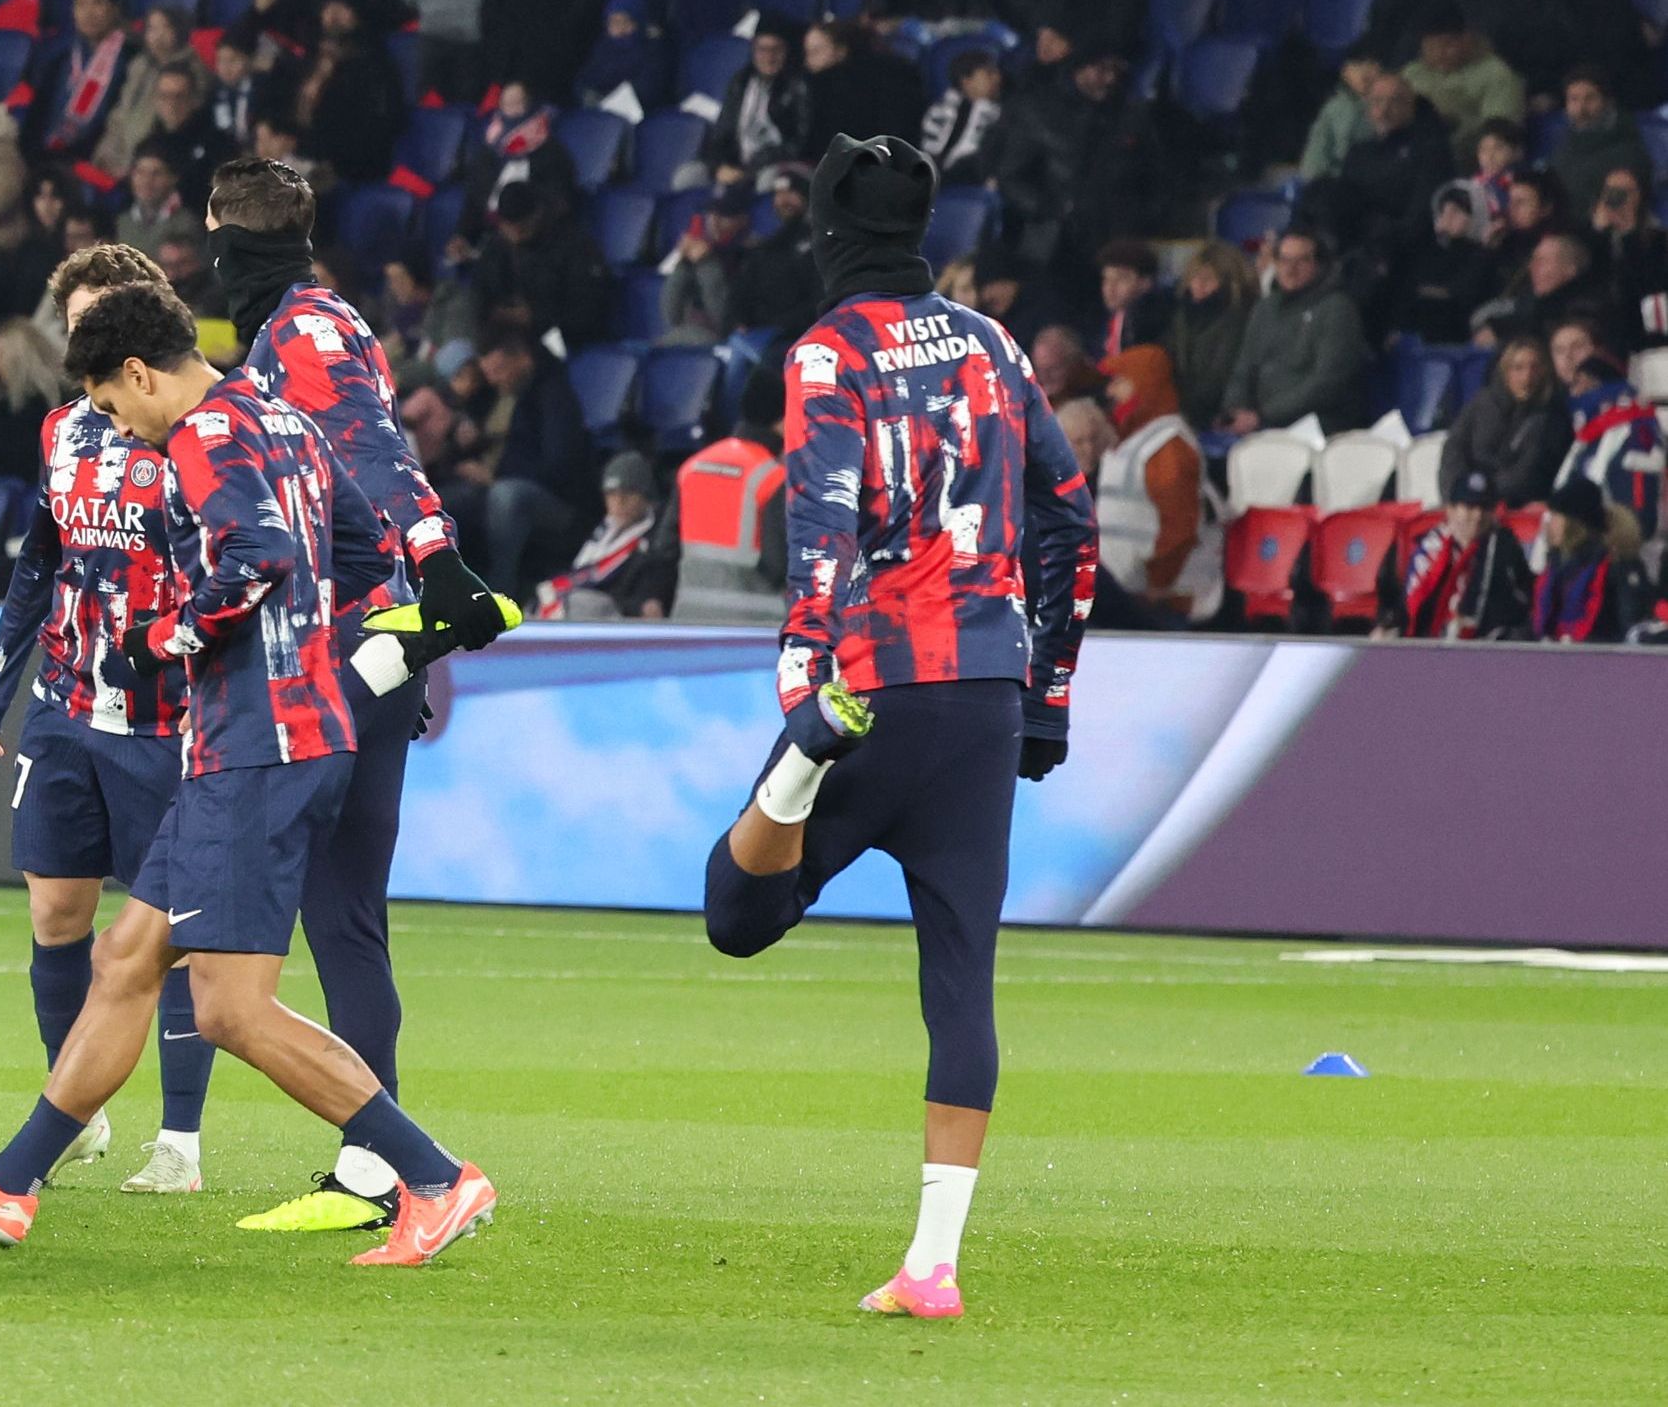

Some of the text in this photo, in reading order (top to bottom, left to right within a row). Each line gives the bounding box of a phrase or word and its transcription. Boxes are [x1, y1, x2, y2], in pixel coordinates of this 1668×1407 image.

[885, 314, 952, 343] VISIT
[872, 334, 987, 373] RWANDA
[51, 496, 146, 531] QATAR
[70, 527, 146, 551] AIRWAYS
